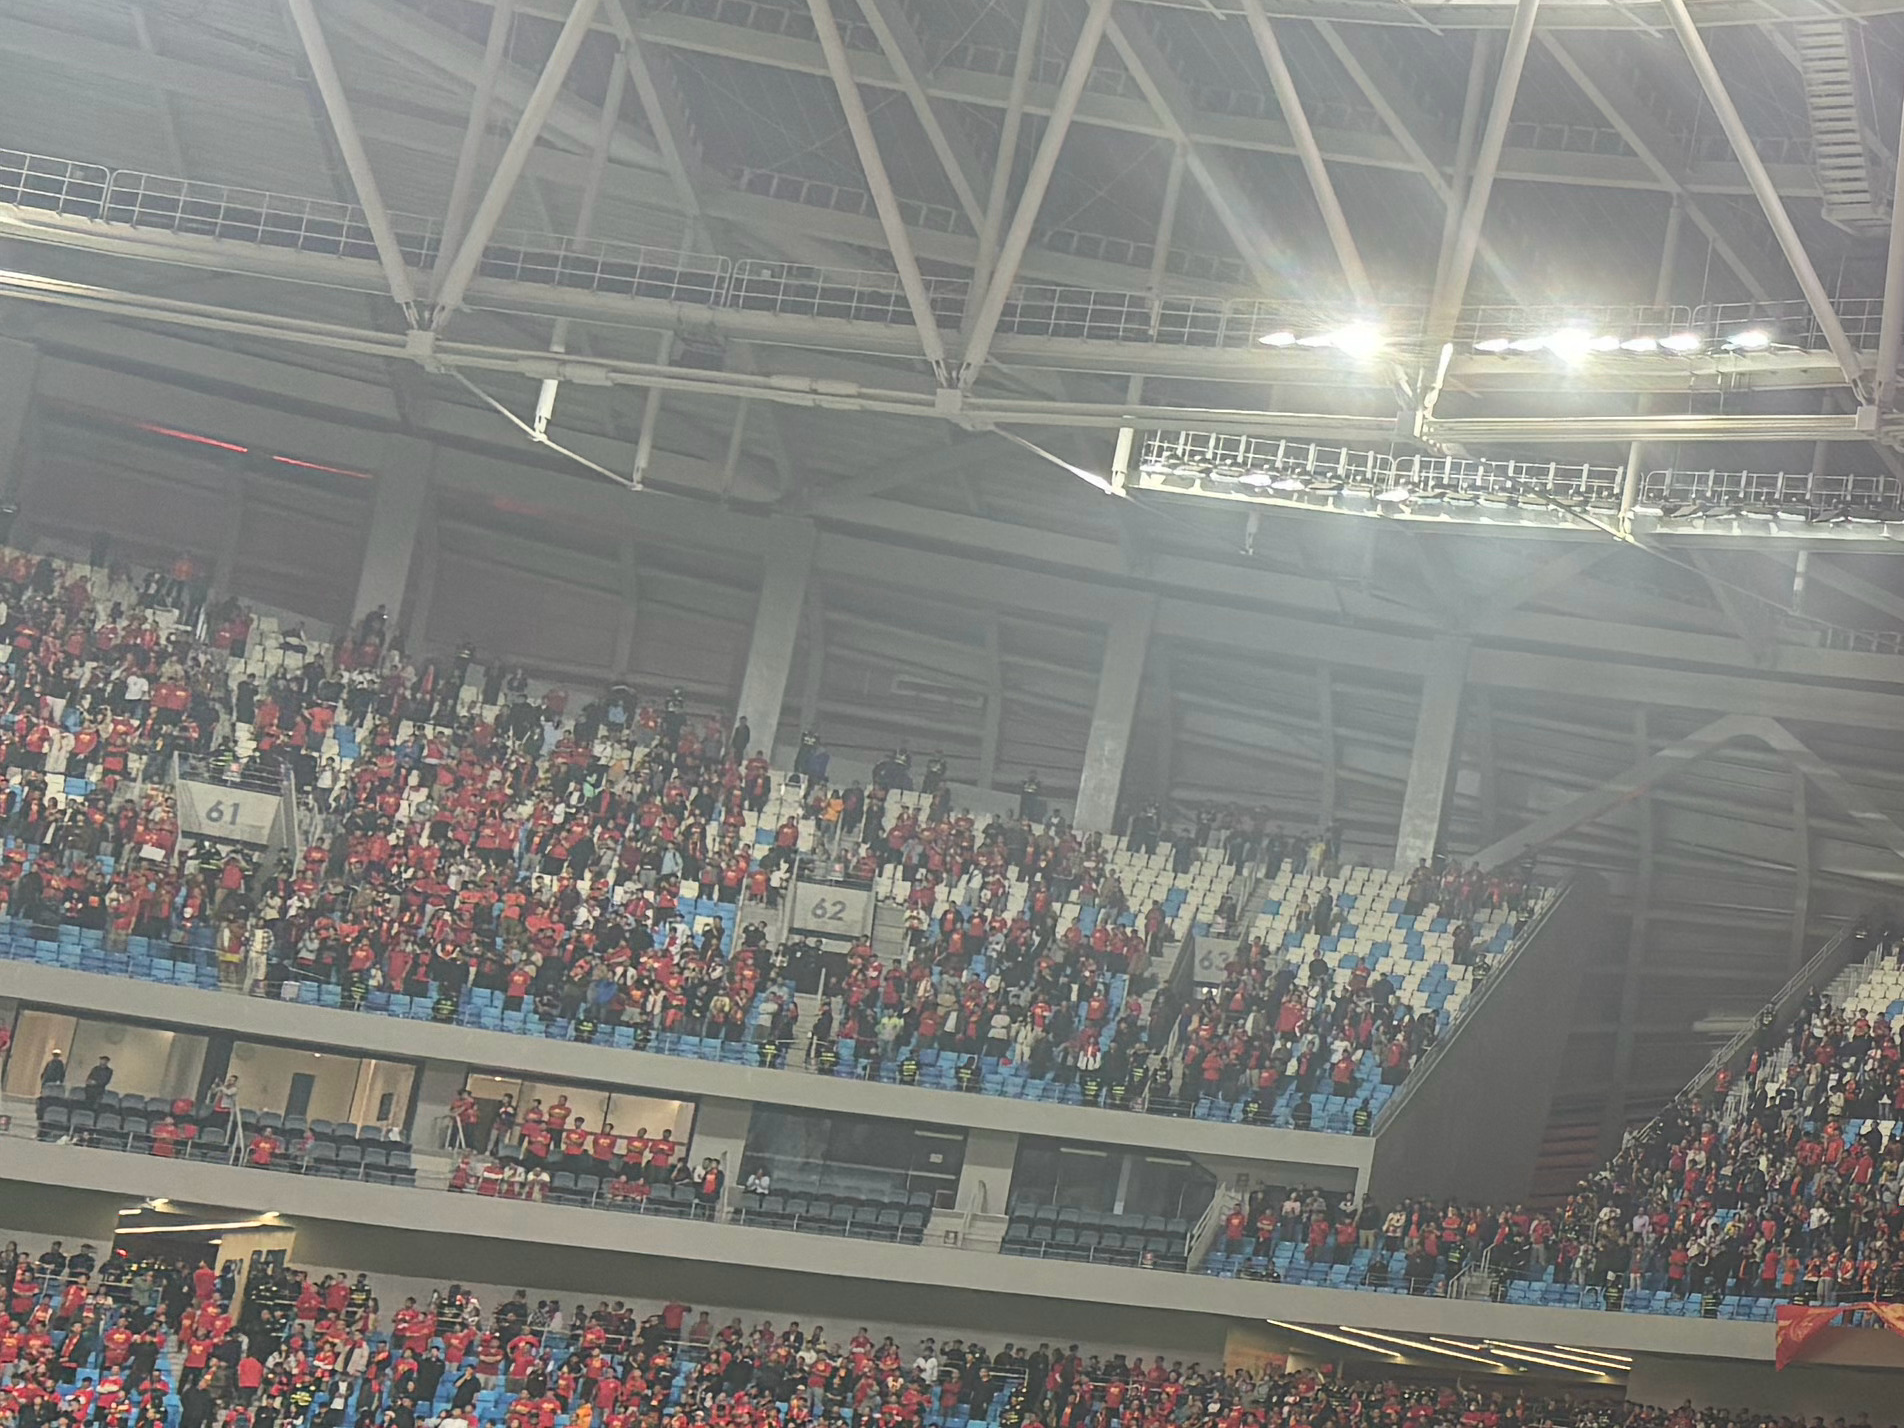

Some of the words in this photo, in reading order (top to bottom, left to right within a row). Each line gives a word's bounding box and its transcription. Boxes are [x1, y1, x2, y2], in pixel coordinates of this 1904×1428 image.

[205, 799, 240, 826] 61
[810, 897, 846, 921] 62
[1198, 949, 1231, 972] 63
